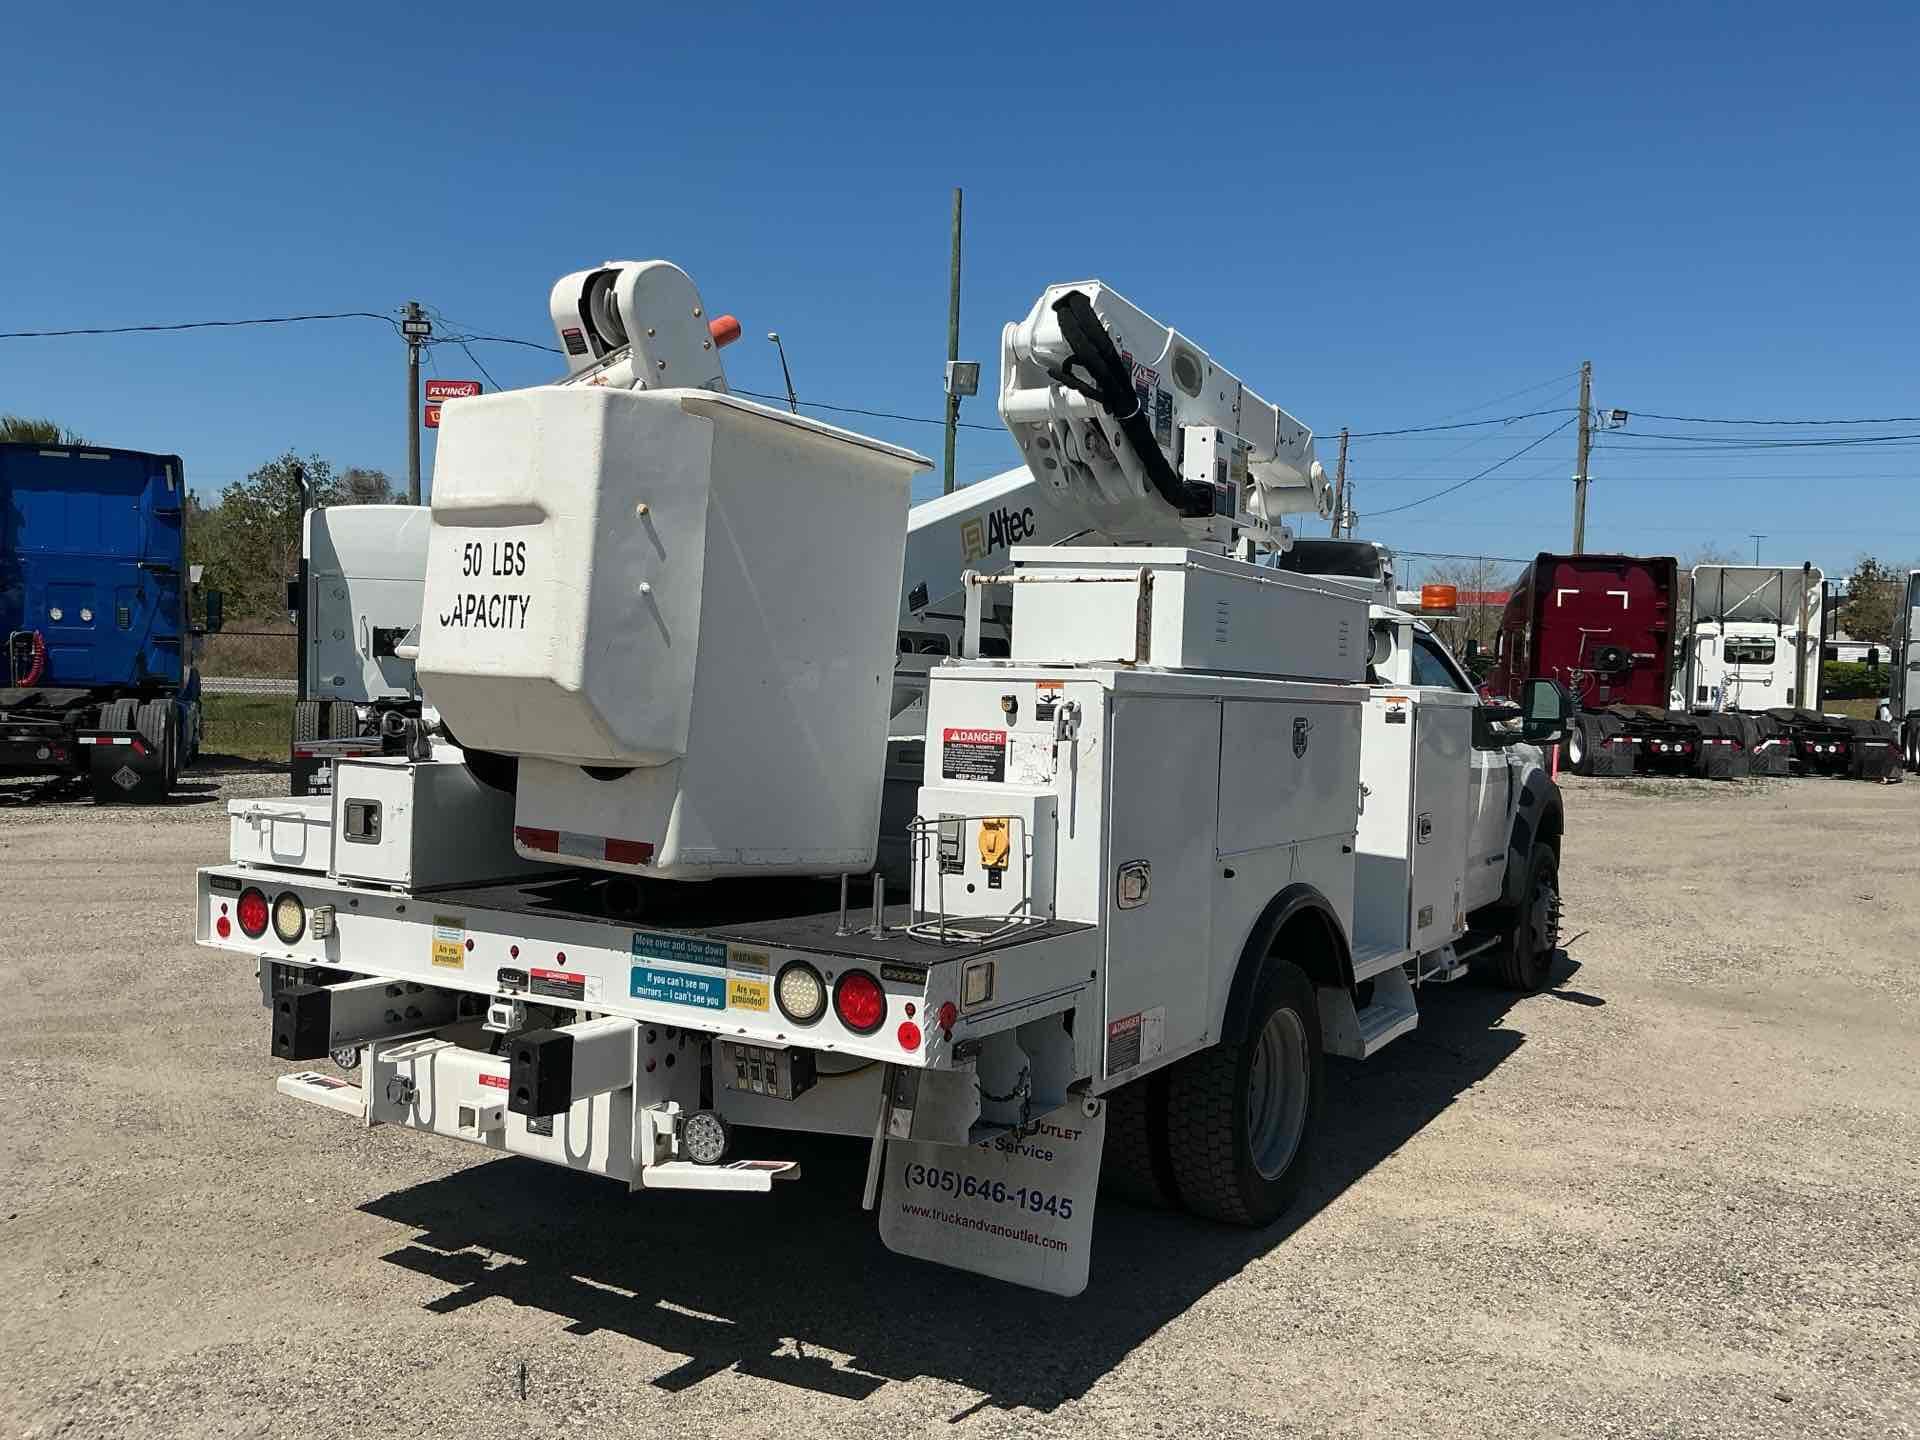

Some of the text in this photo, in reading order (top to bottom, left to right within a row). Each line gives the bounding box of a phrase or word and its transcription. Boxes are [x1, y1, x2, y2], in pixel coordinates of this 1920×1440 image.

[430, 386, 464, 396] FLYING
[987, 506, 1035, 555] Altec
[492, 541, 526, 576] LBS
[960, 731, 1002, 742] DANGER
[635, 934, 655, 946] Move
[655, 939, 671, 949] over
[672, 940, 685, 951] and
[687, 942, 703, 953] slow
[704, 943, 725, 957] down
[653, 975, 665, 984] you
[666, 975, 684, 987] can't
[685, 981, 697, 989] see
[699, 982, 710, 991] my
[736, 983, 748, 993] Are
[636, 985, 662, 997] mirrors
[673, 992, 691, 1001] can't
[692, 994, 705, 1003] see
[706, 997, 719, 1006] you
[1040, 1123, 1082, 1141] UTLET
[995, 1137, 1054, 1161] Service
[905, 1163, 1073, 1220] (305)646-1945
[902, 1203, 1068, 1252] www.truckandvanoutlet.com
